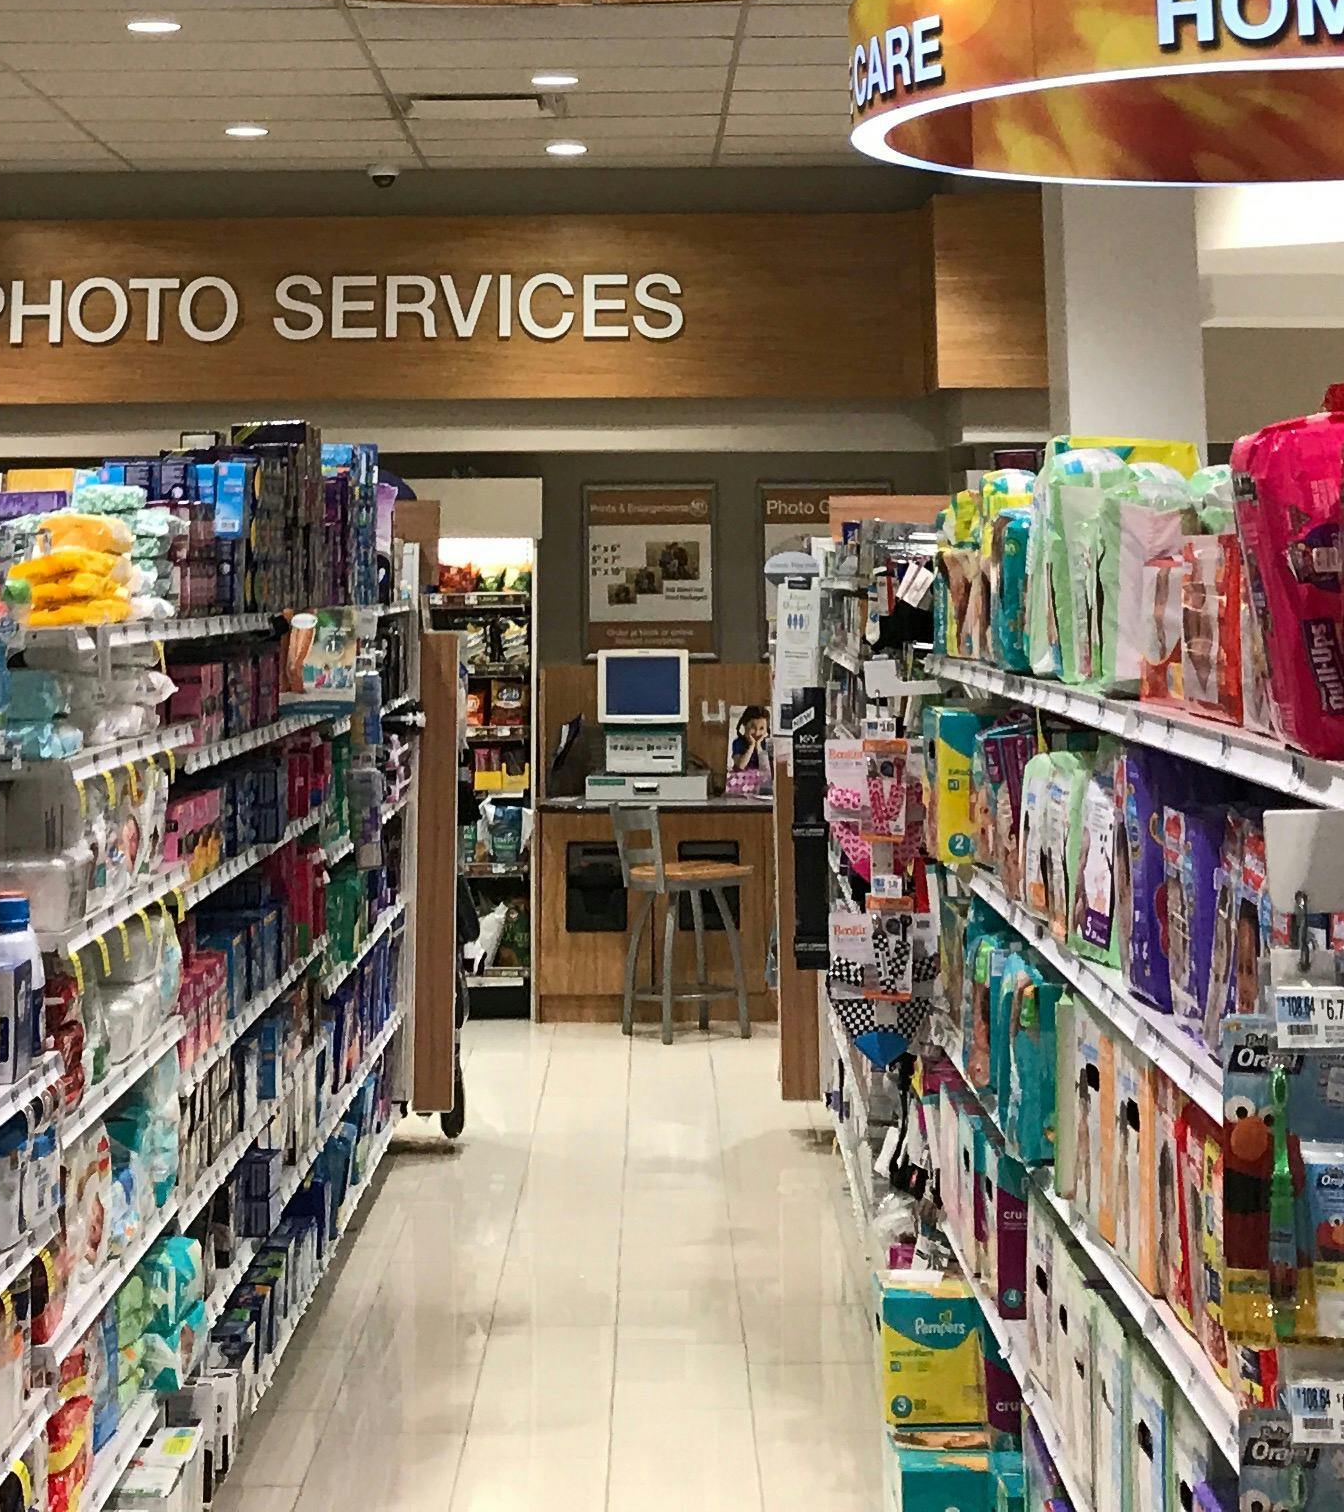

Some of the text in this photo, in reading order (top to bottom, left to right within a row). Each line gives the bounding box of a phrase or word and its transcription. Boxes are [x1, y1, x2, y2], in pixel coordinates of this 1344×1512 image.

[272, 273, 686, 342] SERVICES
[765, 500, 815, 516] Photo
[915, 1317, 965, 1336] Pampers
